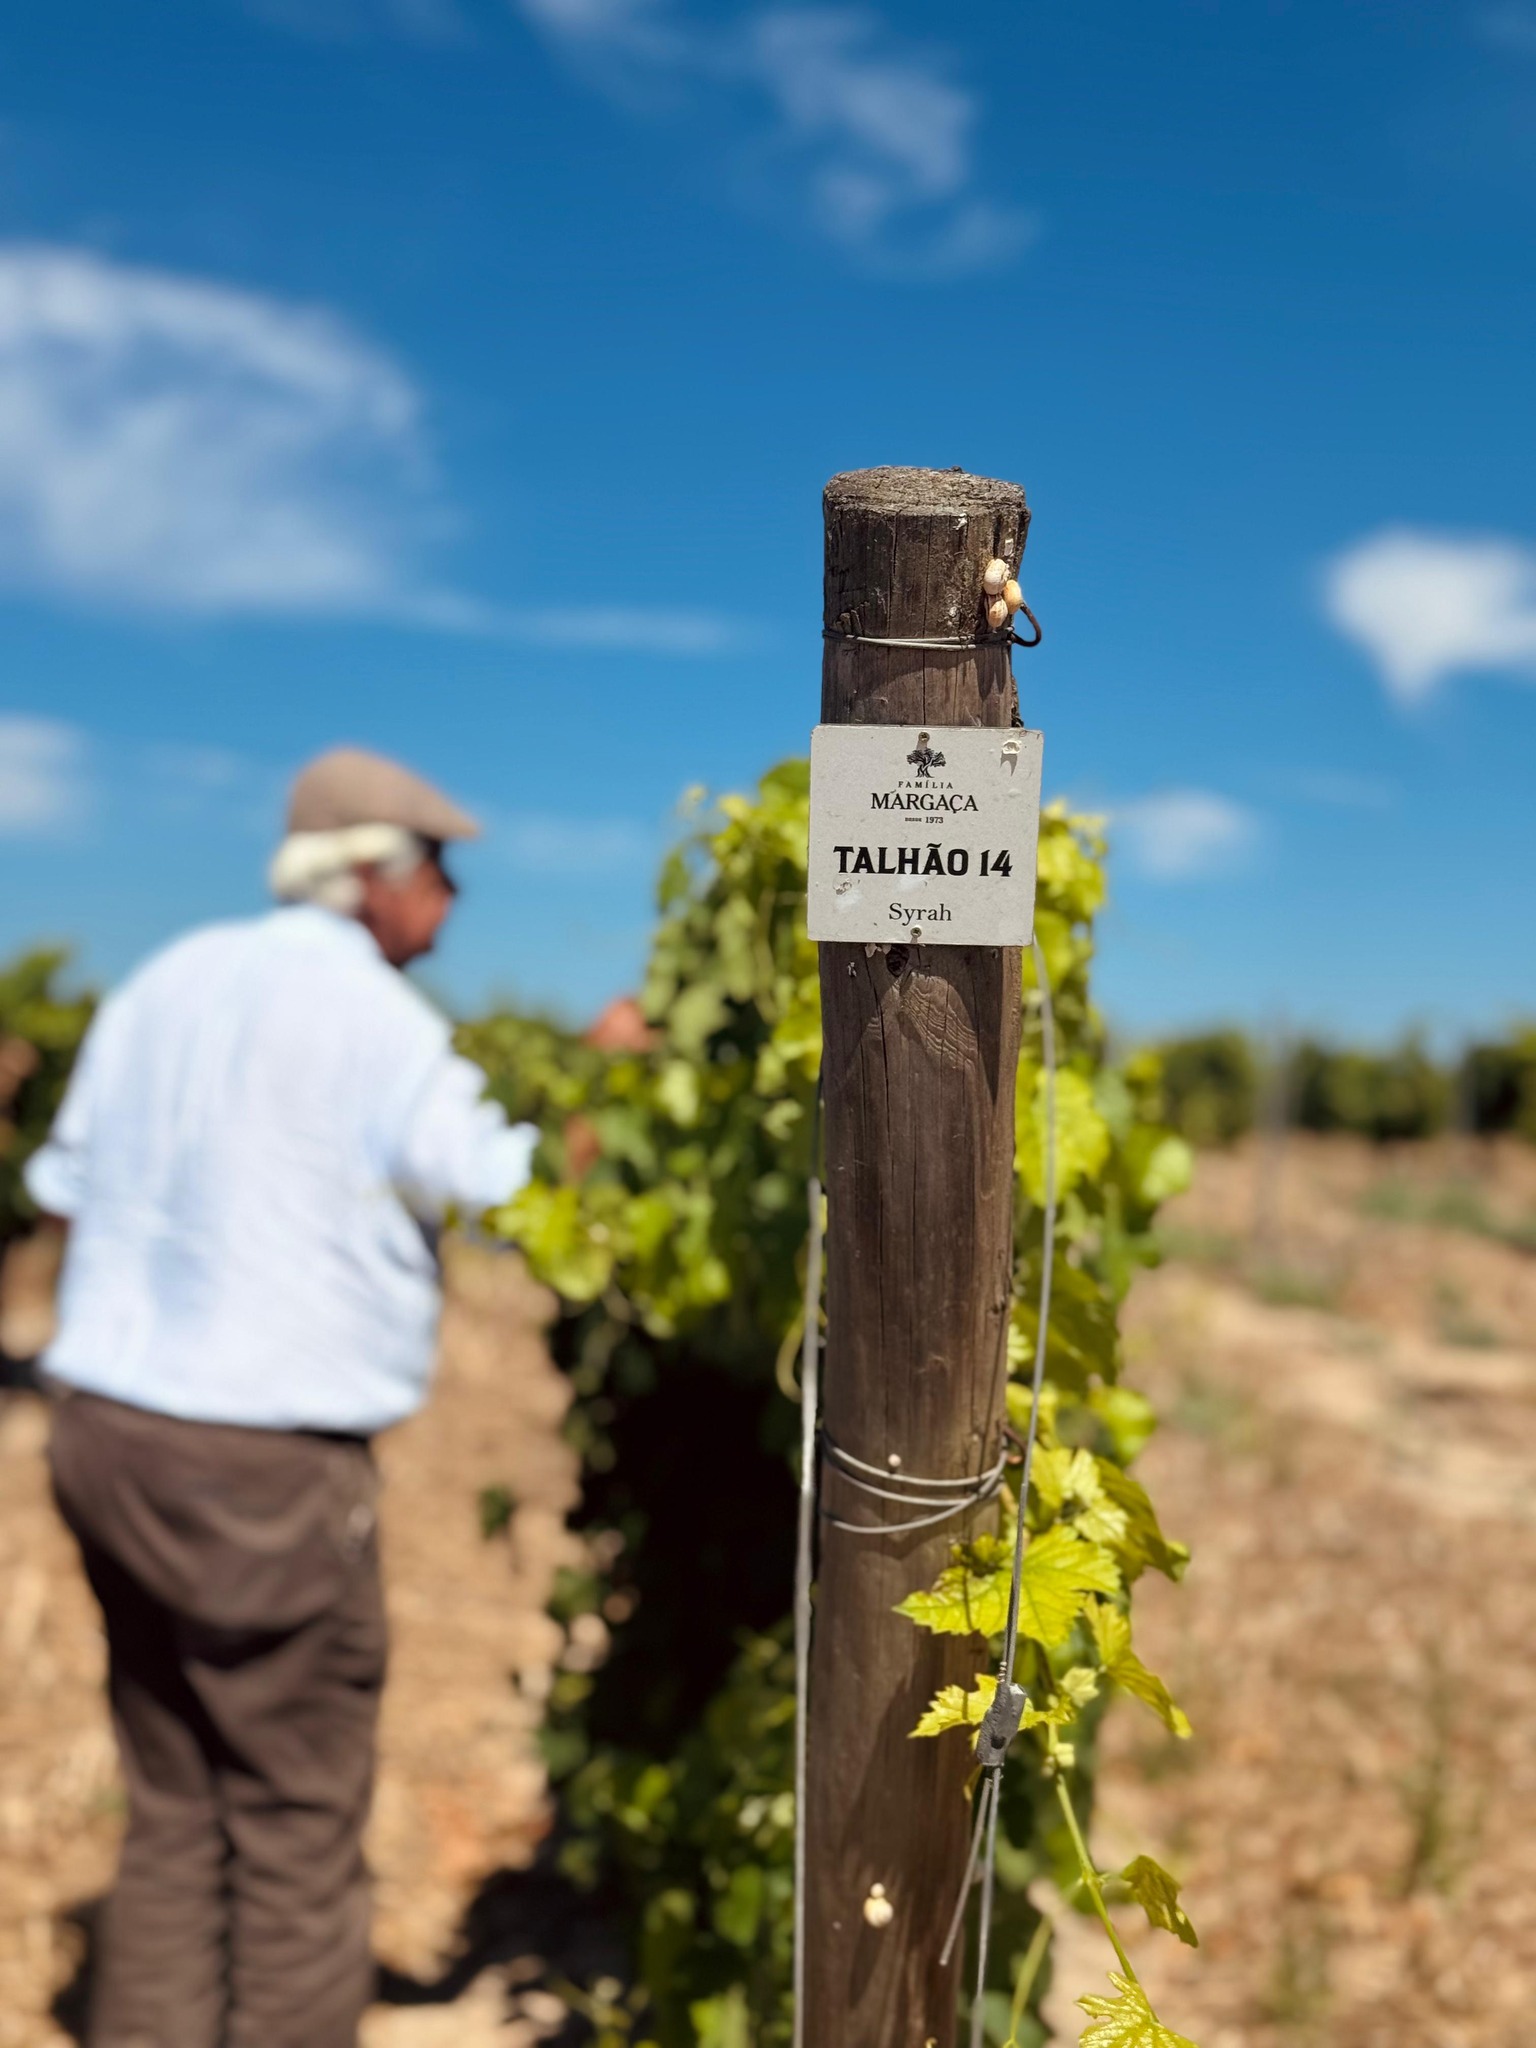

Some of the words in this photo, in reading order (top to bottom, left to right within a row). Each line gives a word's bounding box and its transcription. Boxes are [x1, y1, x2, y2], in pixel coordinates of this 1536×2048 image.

[898, 780, 953, 789] FAMÍLIA
[870, 793, 979, 814] MARGAÇA
[925, 816, 944, 824] 1973
[833, 843, 969, 876] TALHÃO
[979, 850, 1013, 877] 14
[888, 902, 952, 927] Syrah
